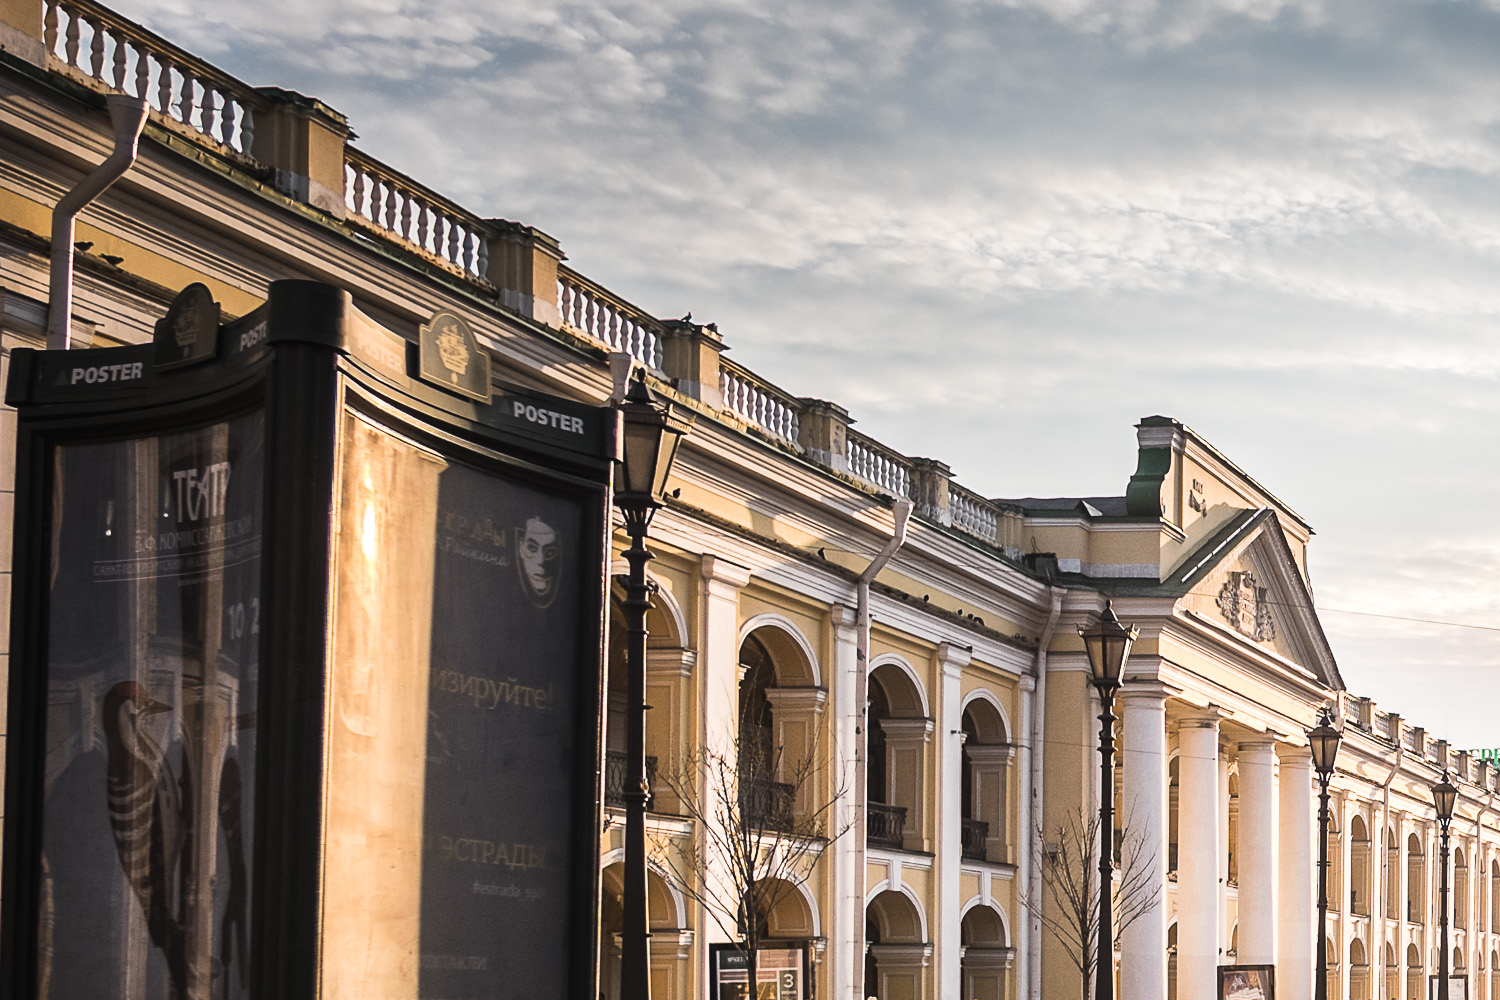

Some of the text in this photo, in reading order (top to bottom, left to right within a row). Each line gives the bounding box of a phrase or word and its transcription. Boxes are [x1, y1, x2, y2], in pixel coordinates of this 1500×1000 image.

[239, 320, 267, 353] POST
[70, 361, 143, 385] POSTER
[513, 402, 585, 435] POSTER
[173, 461, 231, 523] ТЕАТР
[430, 668, 555, 710] изируйте!
[438, 836, 546, 872] ЭСТРАДЫ
[783, 973, 794, 989] 3
